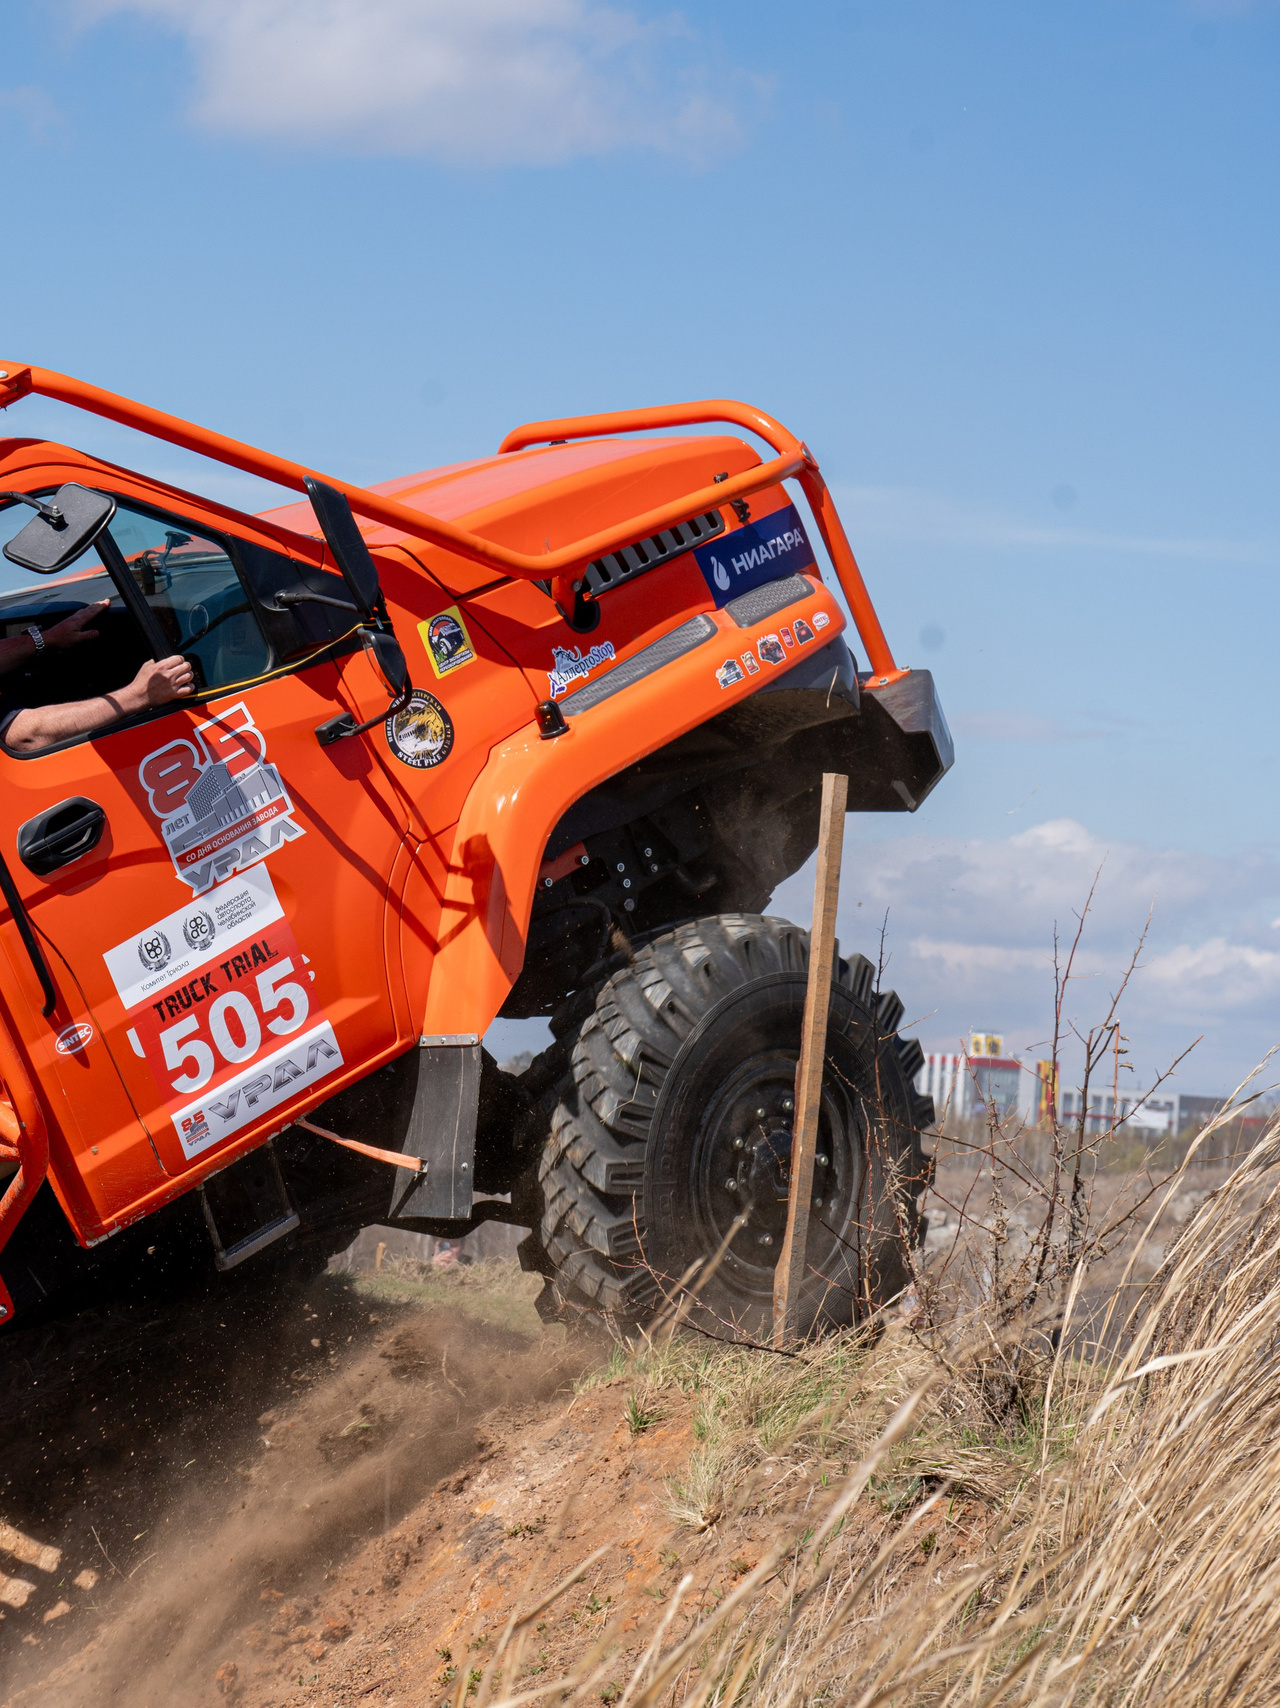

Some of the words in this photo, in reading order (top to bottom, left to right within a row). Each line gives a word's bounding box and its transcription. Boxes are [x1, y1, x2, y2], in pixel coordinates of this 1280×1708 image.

[731, 530, 805, 575] НИАГАРА
[139, 702, 266, 817] 85
[397, 751, 422, 767] STEEL
[165, 813, 190, 836] лет
[186, 853, 197, 863] СО
[197, 844, 212, 859] ДНЯ
[212, 822, 252, 849] ОСНОВАНИЯ
[252, 806, 279, 828] ЗАВОДА
[184, 820, 298, 889] УРАЛ
[217, 896, 252, 919] автоспорта
[217, 901, 256, 926] челябинской
[227, 912, 252, 929] области
[141, 973, 167, 992] Комитет
[167, 960, 190, 977] Триала
[152, 971, 219, 1023] TRUCK
[219, 940, 279, 982] TRIAL
[57, 1026, 91, 1051] SINTEC
[159, 956, 310, 1094] 505
[208, 1038, 339, 1124] УРАЛ
[181, 1110, 205, 1132] 85
